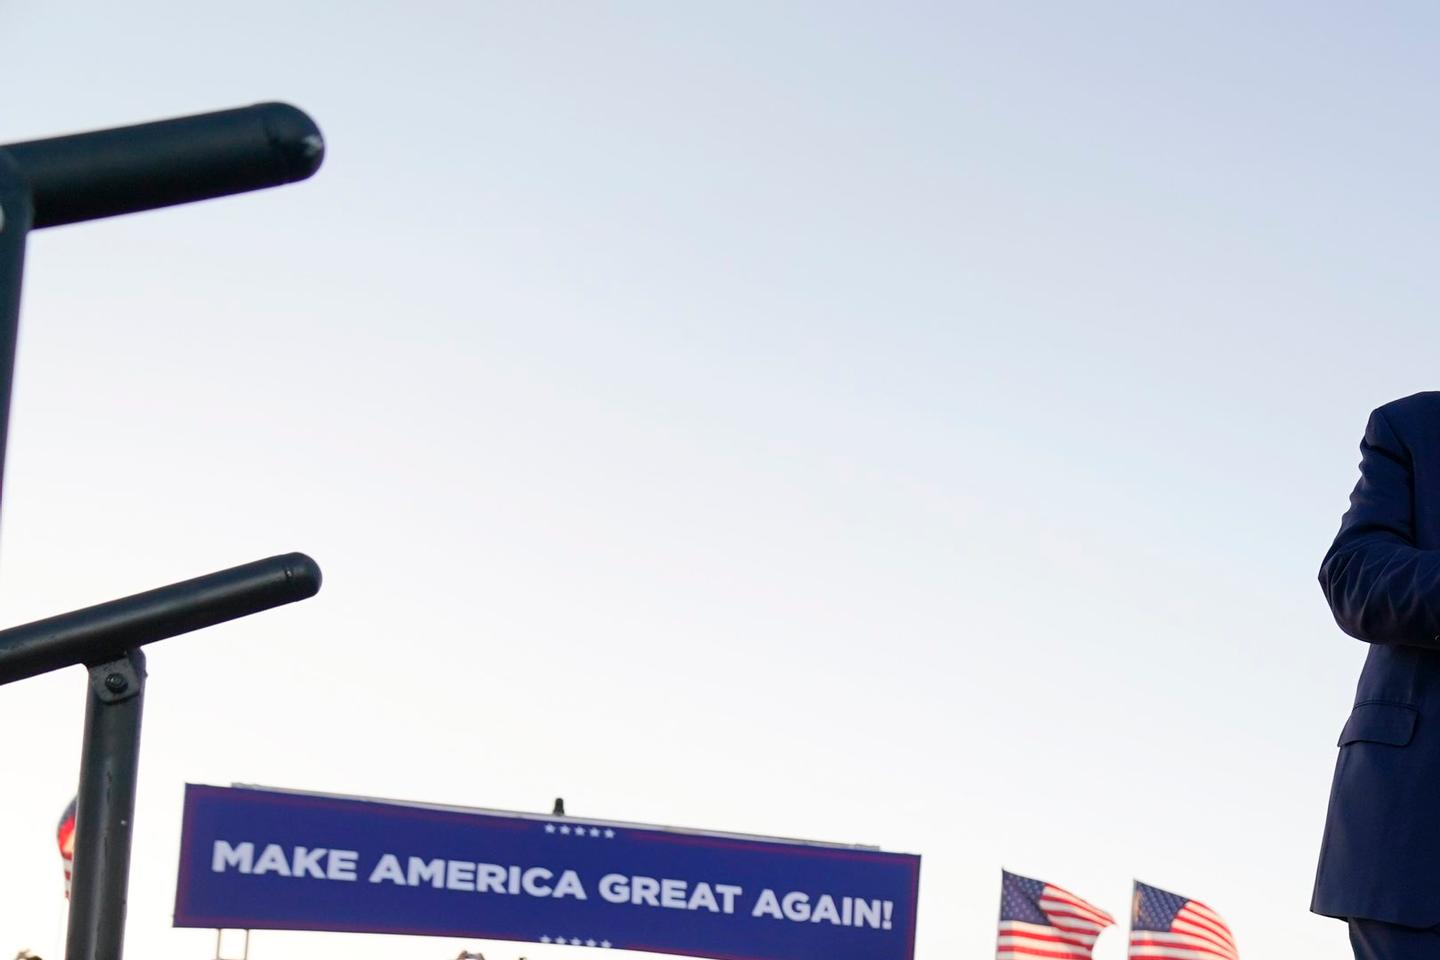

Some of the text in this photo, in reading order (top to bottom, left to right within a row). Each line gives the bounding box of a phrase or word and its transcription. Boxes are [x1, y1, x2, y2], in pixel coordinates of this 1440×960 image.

[212, 840, 894, 929] MAKE AMERICA GREAT AGAIN!
